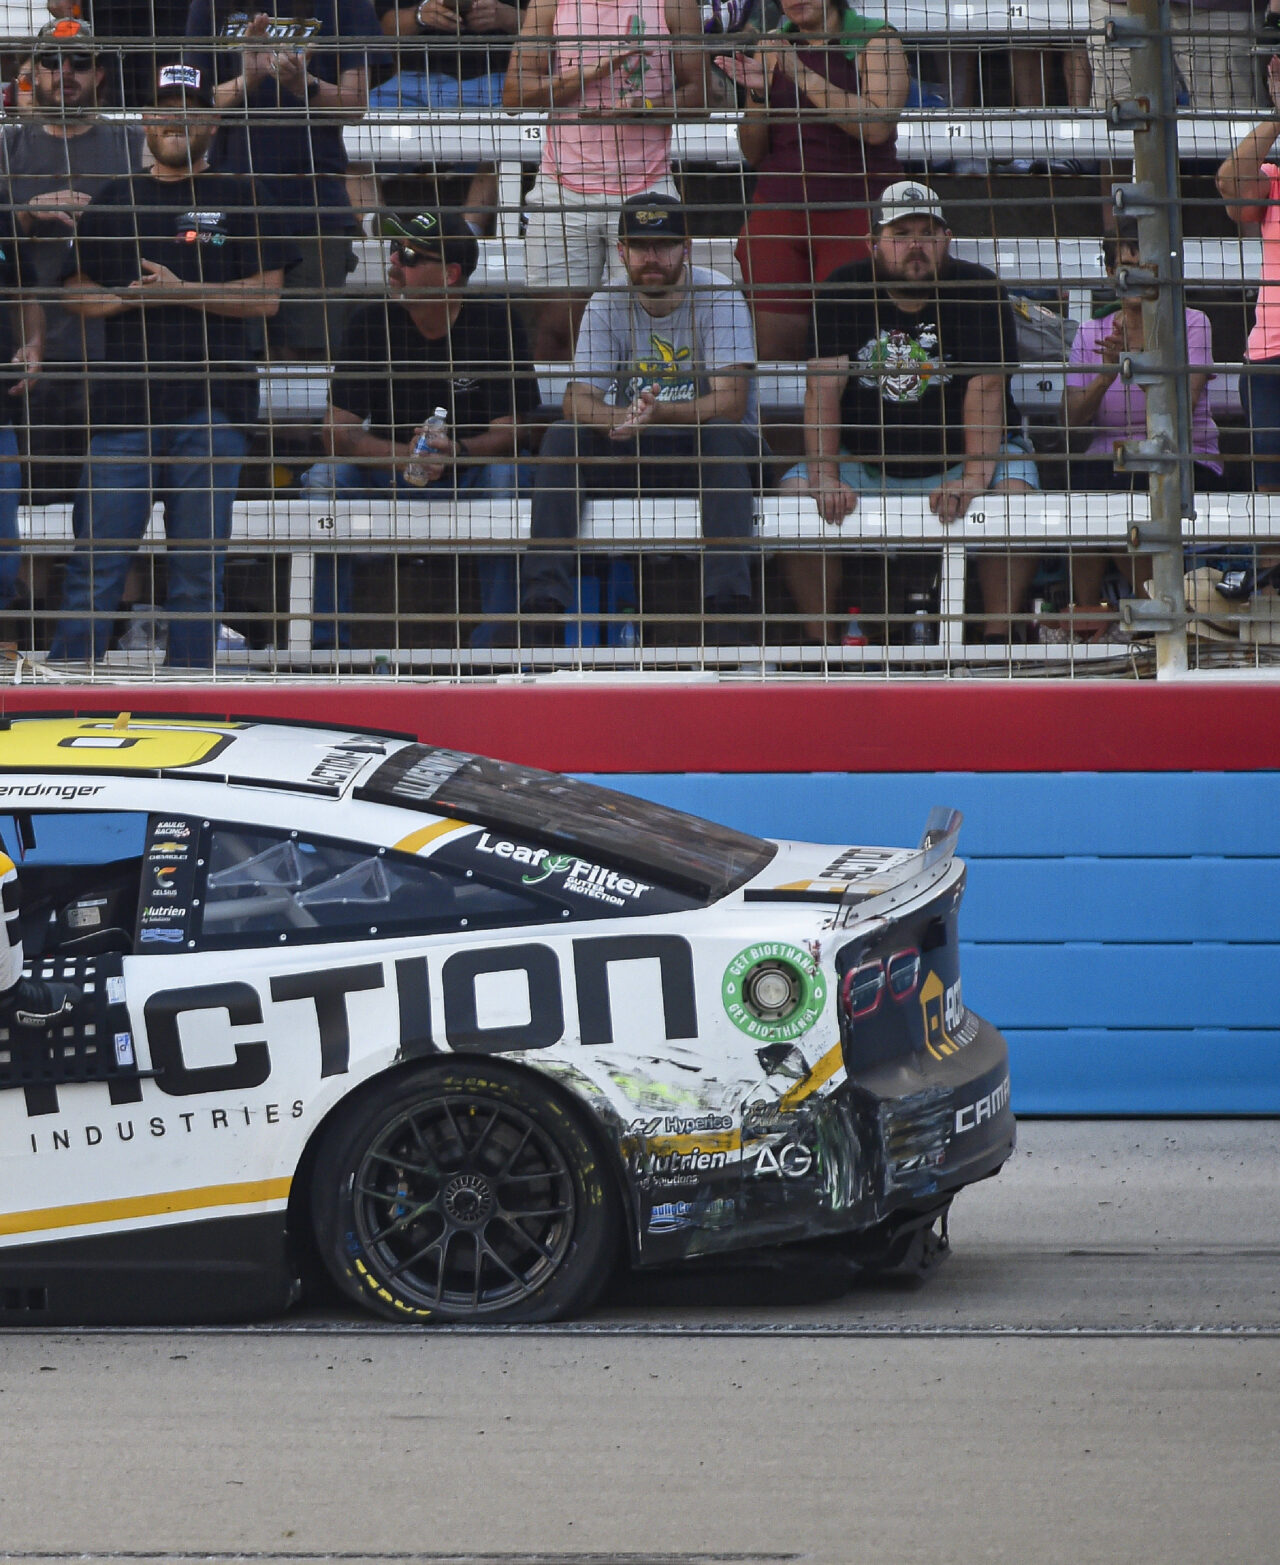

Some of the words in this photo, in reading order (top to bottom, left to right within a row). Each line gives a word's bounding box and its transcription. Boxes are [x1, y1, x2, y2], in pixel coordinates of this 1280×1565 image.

[524, 127, 541, 138] 13
[947, 125, 961, 137] 11
[1036, 380, 1052, 391] 10
[317, 517, 334, 529] 13
[969, 512, 985, 524] 10
[475, 832, 550, 866] Leaf
[571, 860, 650, 899] Filter
[566, 876, 605, 893] GUTTER
[562, 882, 626, 907] PROTECTION
[143, 905, 187, 917] Nutrien
[730, 955, 749, 975] GET
[729, 1003, 749, 1023] GET
[748, 1008, 818, 1038] BIOETHANOL
[30, 1099, 306, 1153] INDUSTRIES
[665, 1113, 733, 1134] Hyperice
